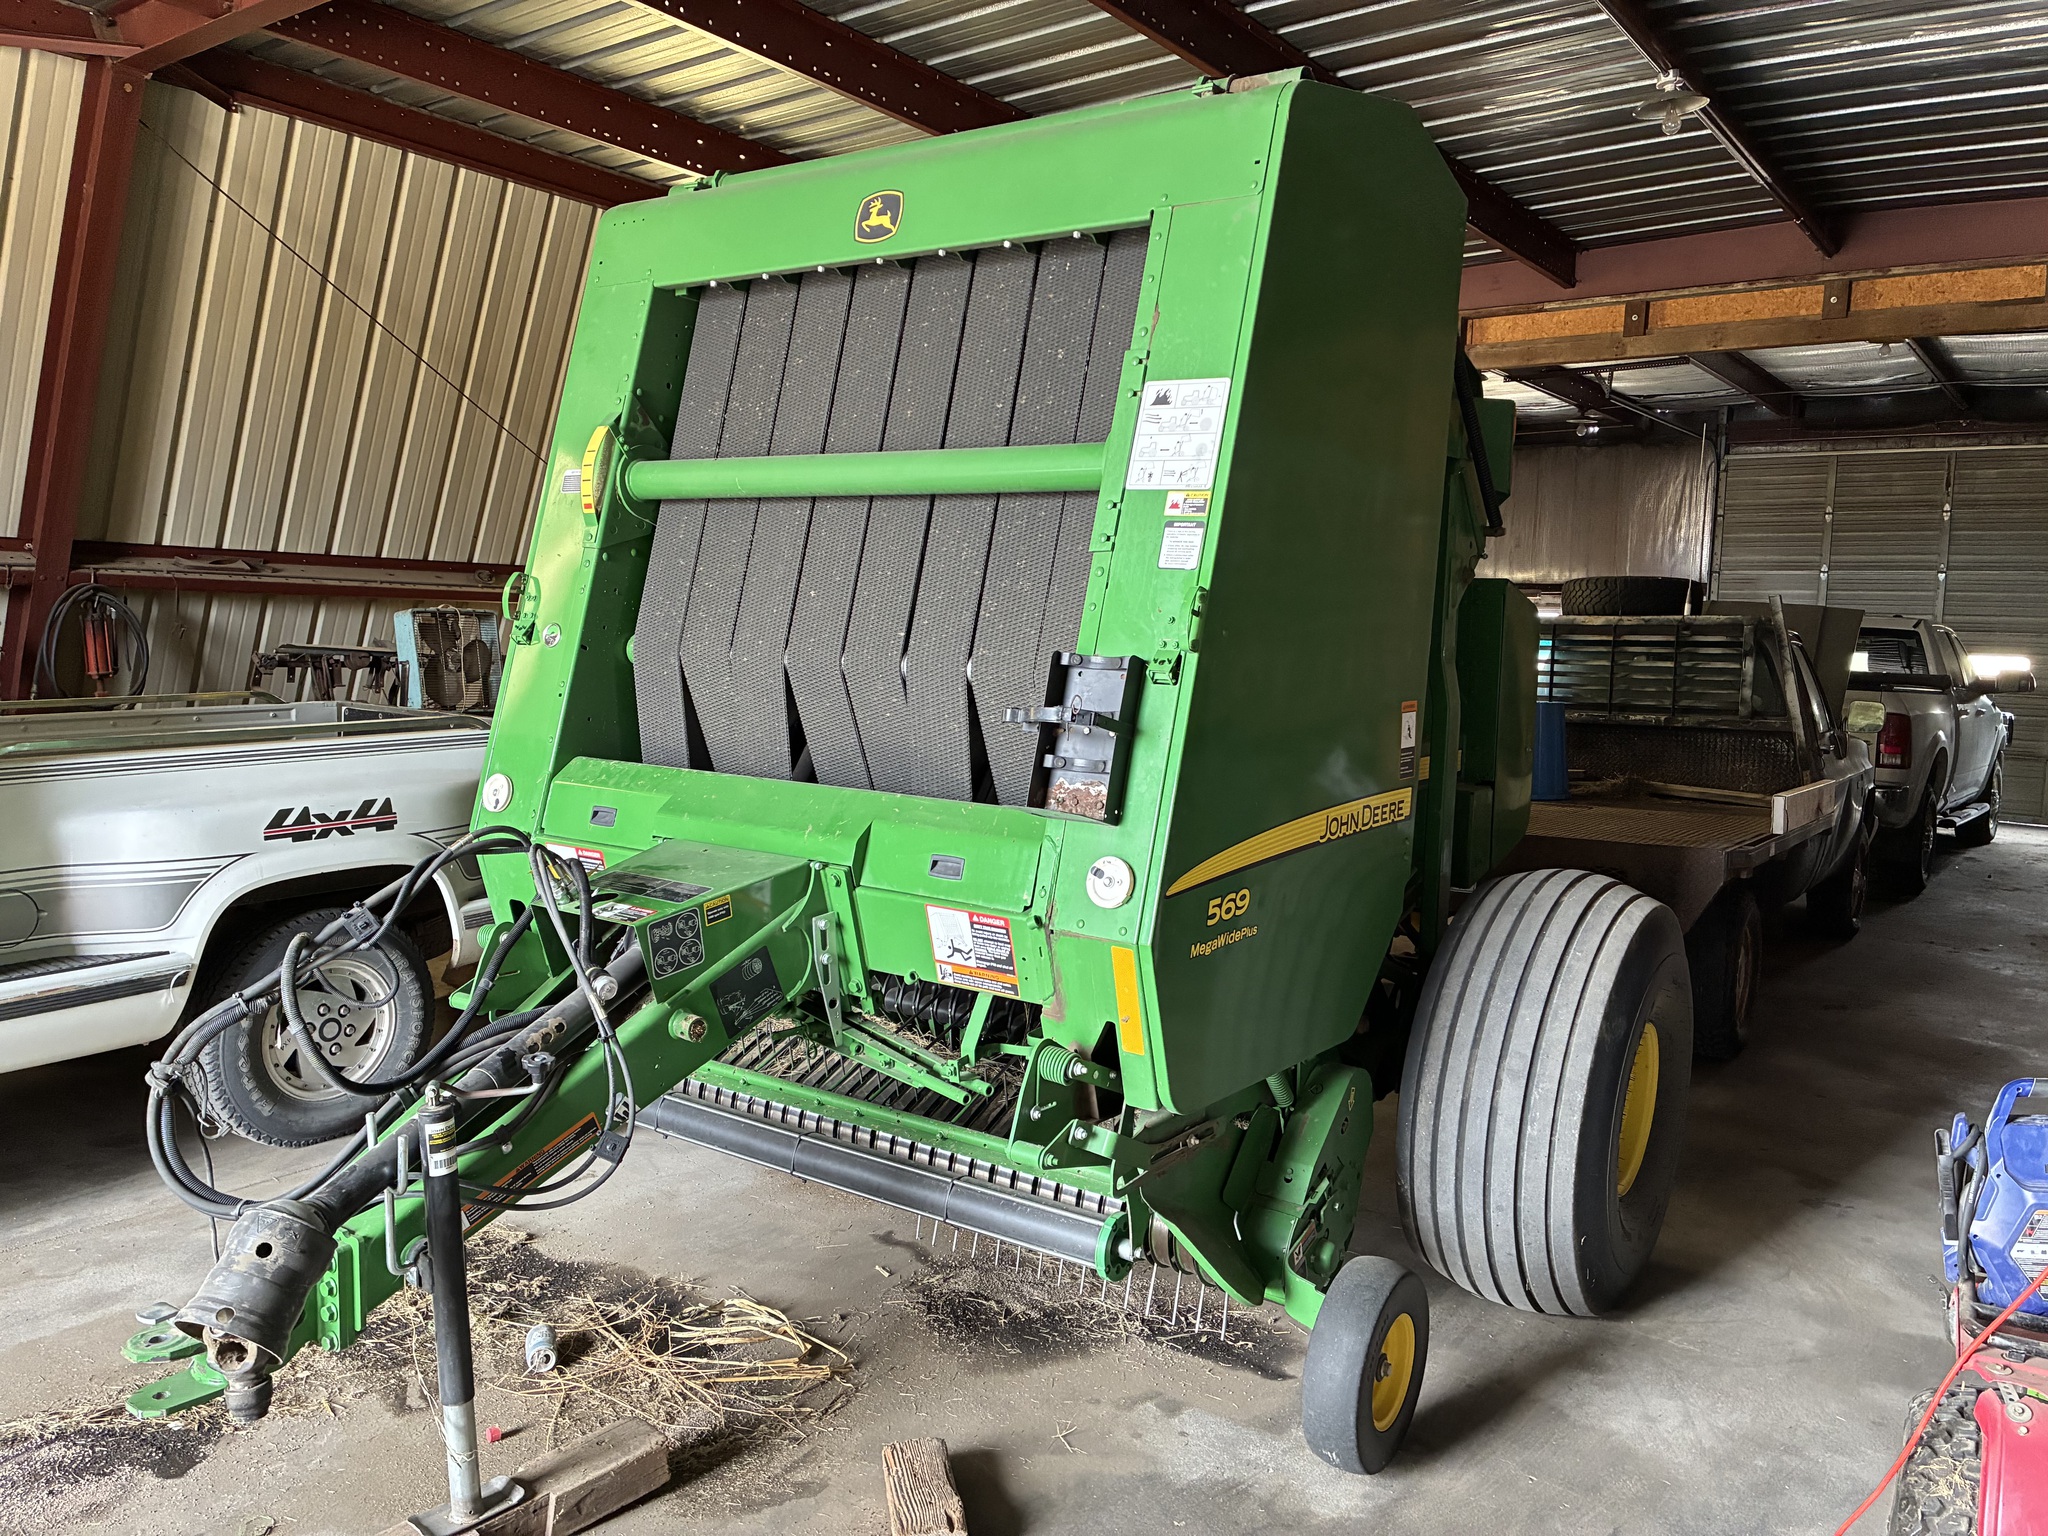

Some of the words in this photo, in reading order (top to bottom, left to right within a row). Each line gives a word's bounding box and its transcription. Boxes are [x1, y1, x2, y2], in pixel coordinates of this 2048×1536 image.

[263, 797, 398, 843] 4x4
[1320, 812, 1360, 842] JOHN
[1360, 799, 1406, 829] DEERE
[979, 916, 1005, 927] DANGER
[1206, 888, 1251, 927] 569
[1190, 926, 1258, 959] MegaWidePlus
